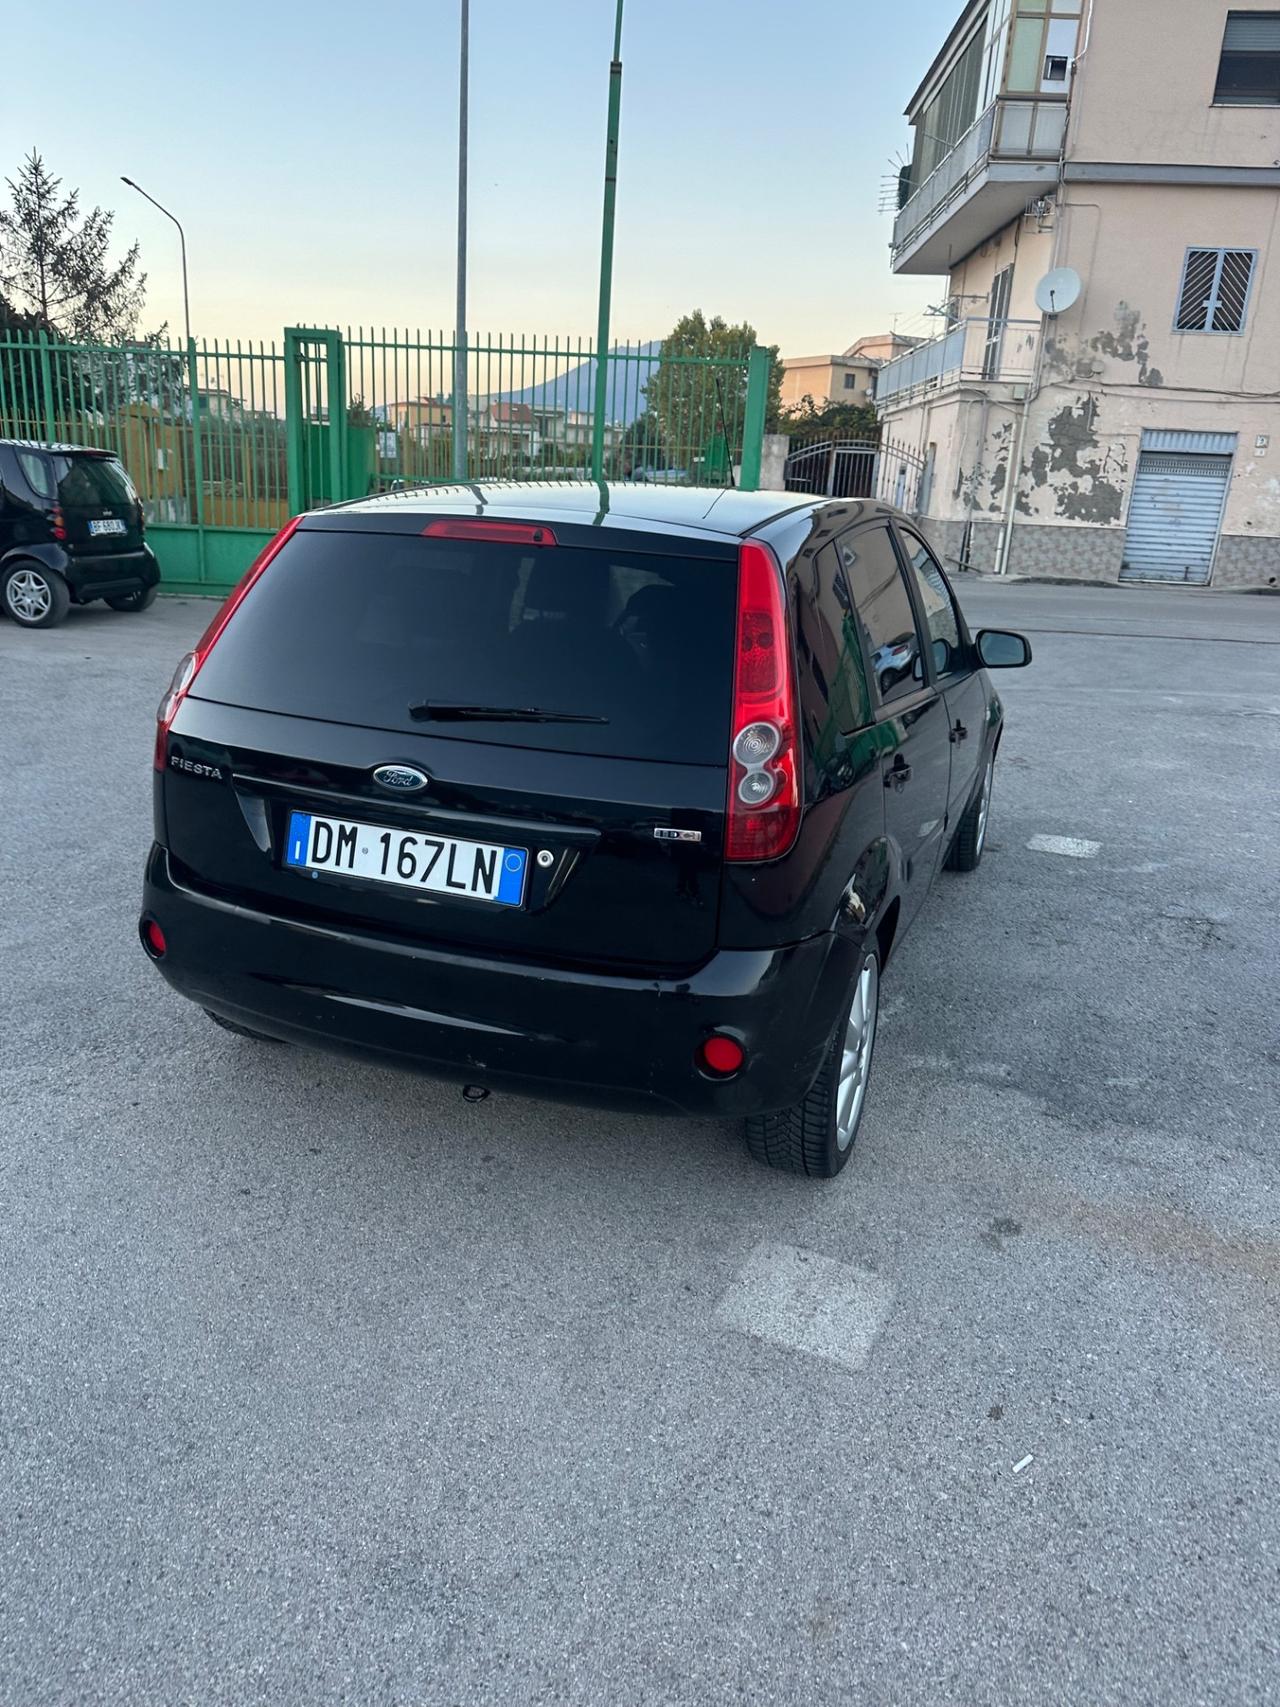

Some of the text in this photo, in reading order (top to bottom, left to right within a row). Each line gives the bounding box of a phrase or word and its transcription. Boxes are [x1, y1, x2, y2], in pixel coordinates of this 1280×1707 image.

[171, 756, 222, 779] FIESTA
[383, 769, 414, 786] Ford
[311, 820, 359, 869] DM
[380, 832, 498, 894] 167LN
